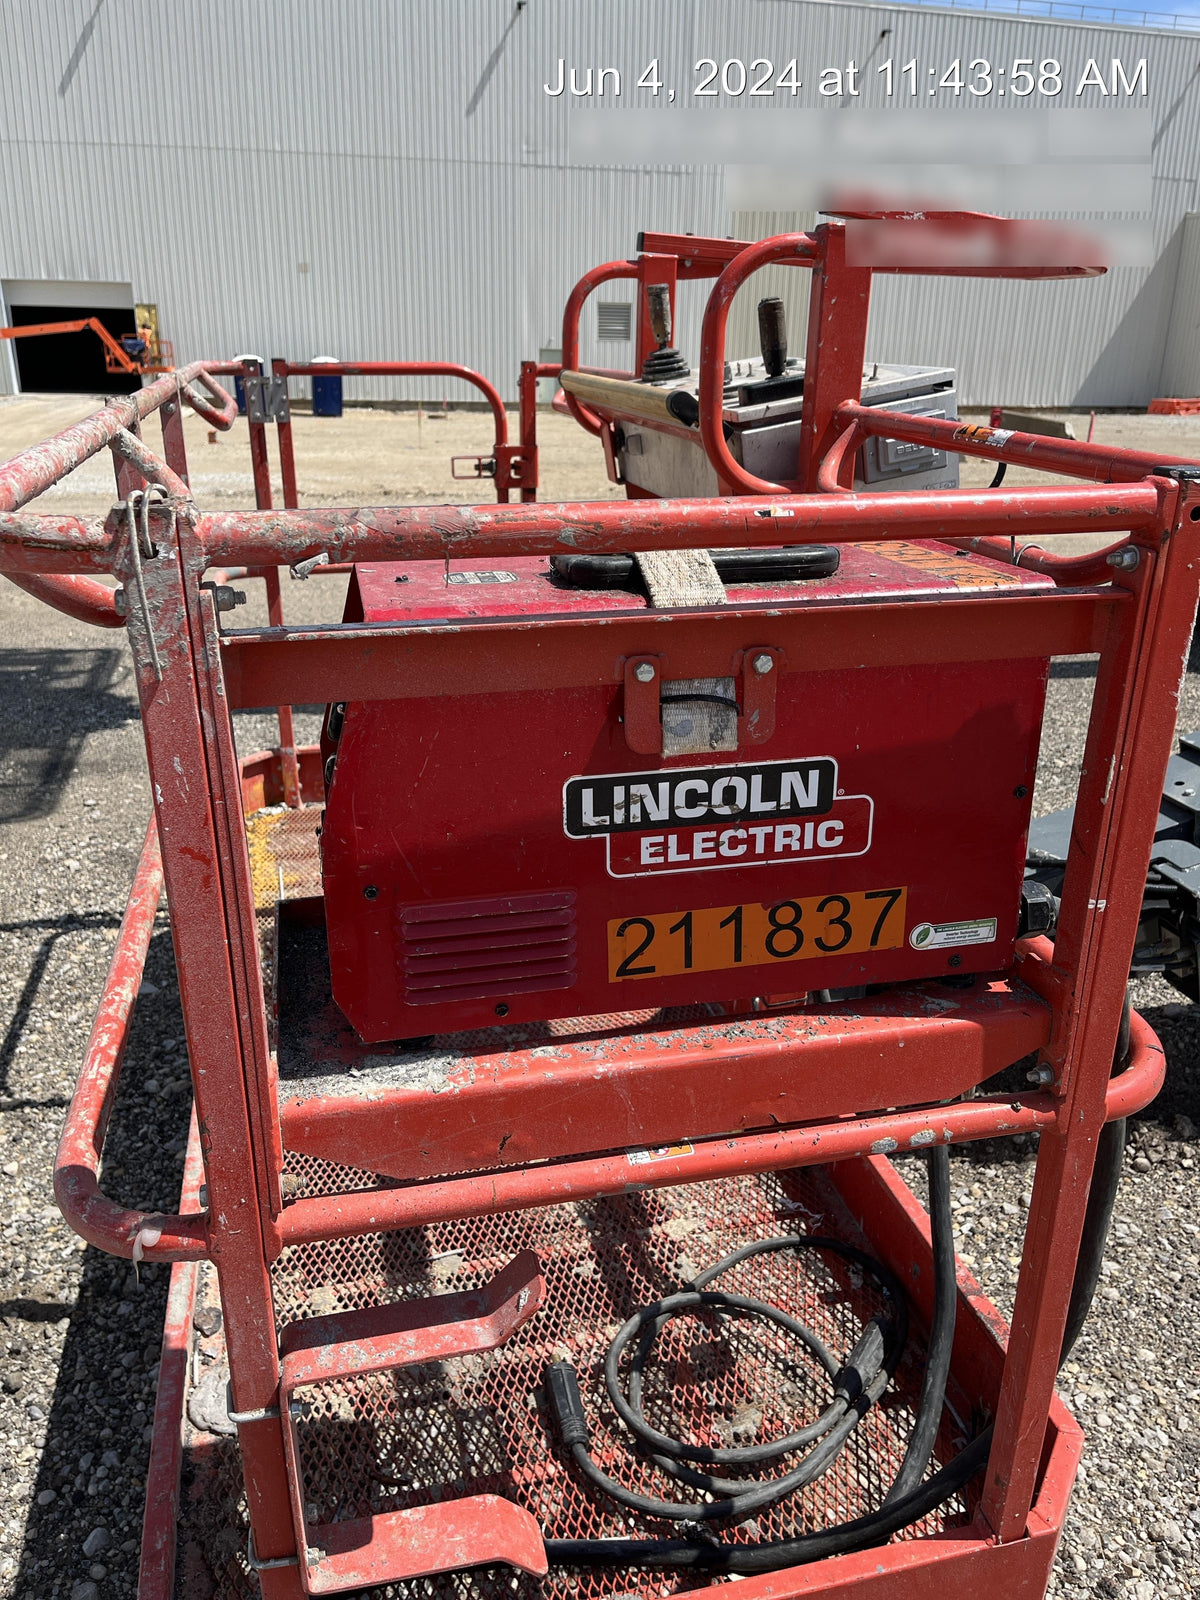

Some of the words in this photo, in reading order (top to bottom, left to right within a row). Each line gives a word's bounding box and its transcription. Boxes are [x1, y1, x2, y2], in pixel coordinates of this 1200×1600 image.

[581, 769, 820, 827] LINCOLN
[640, 819, 844, 865] ELECTRIC
[615, 888, 903, 978] 211837
